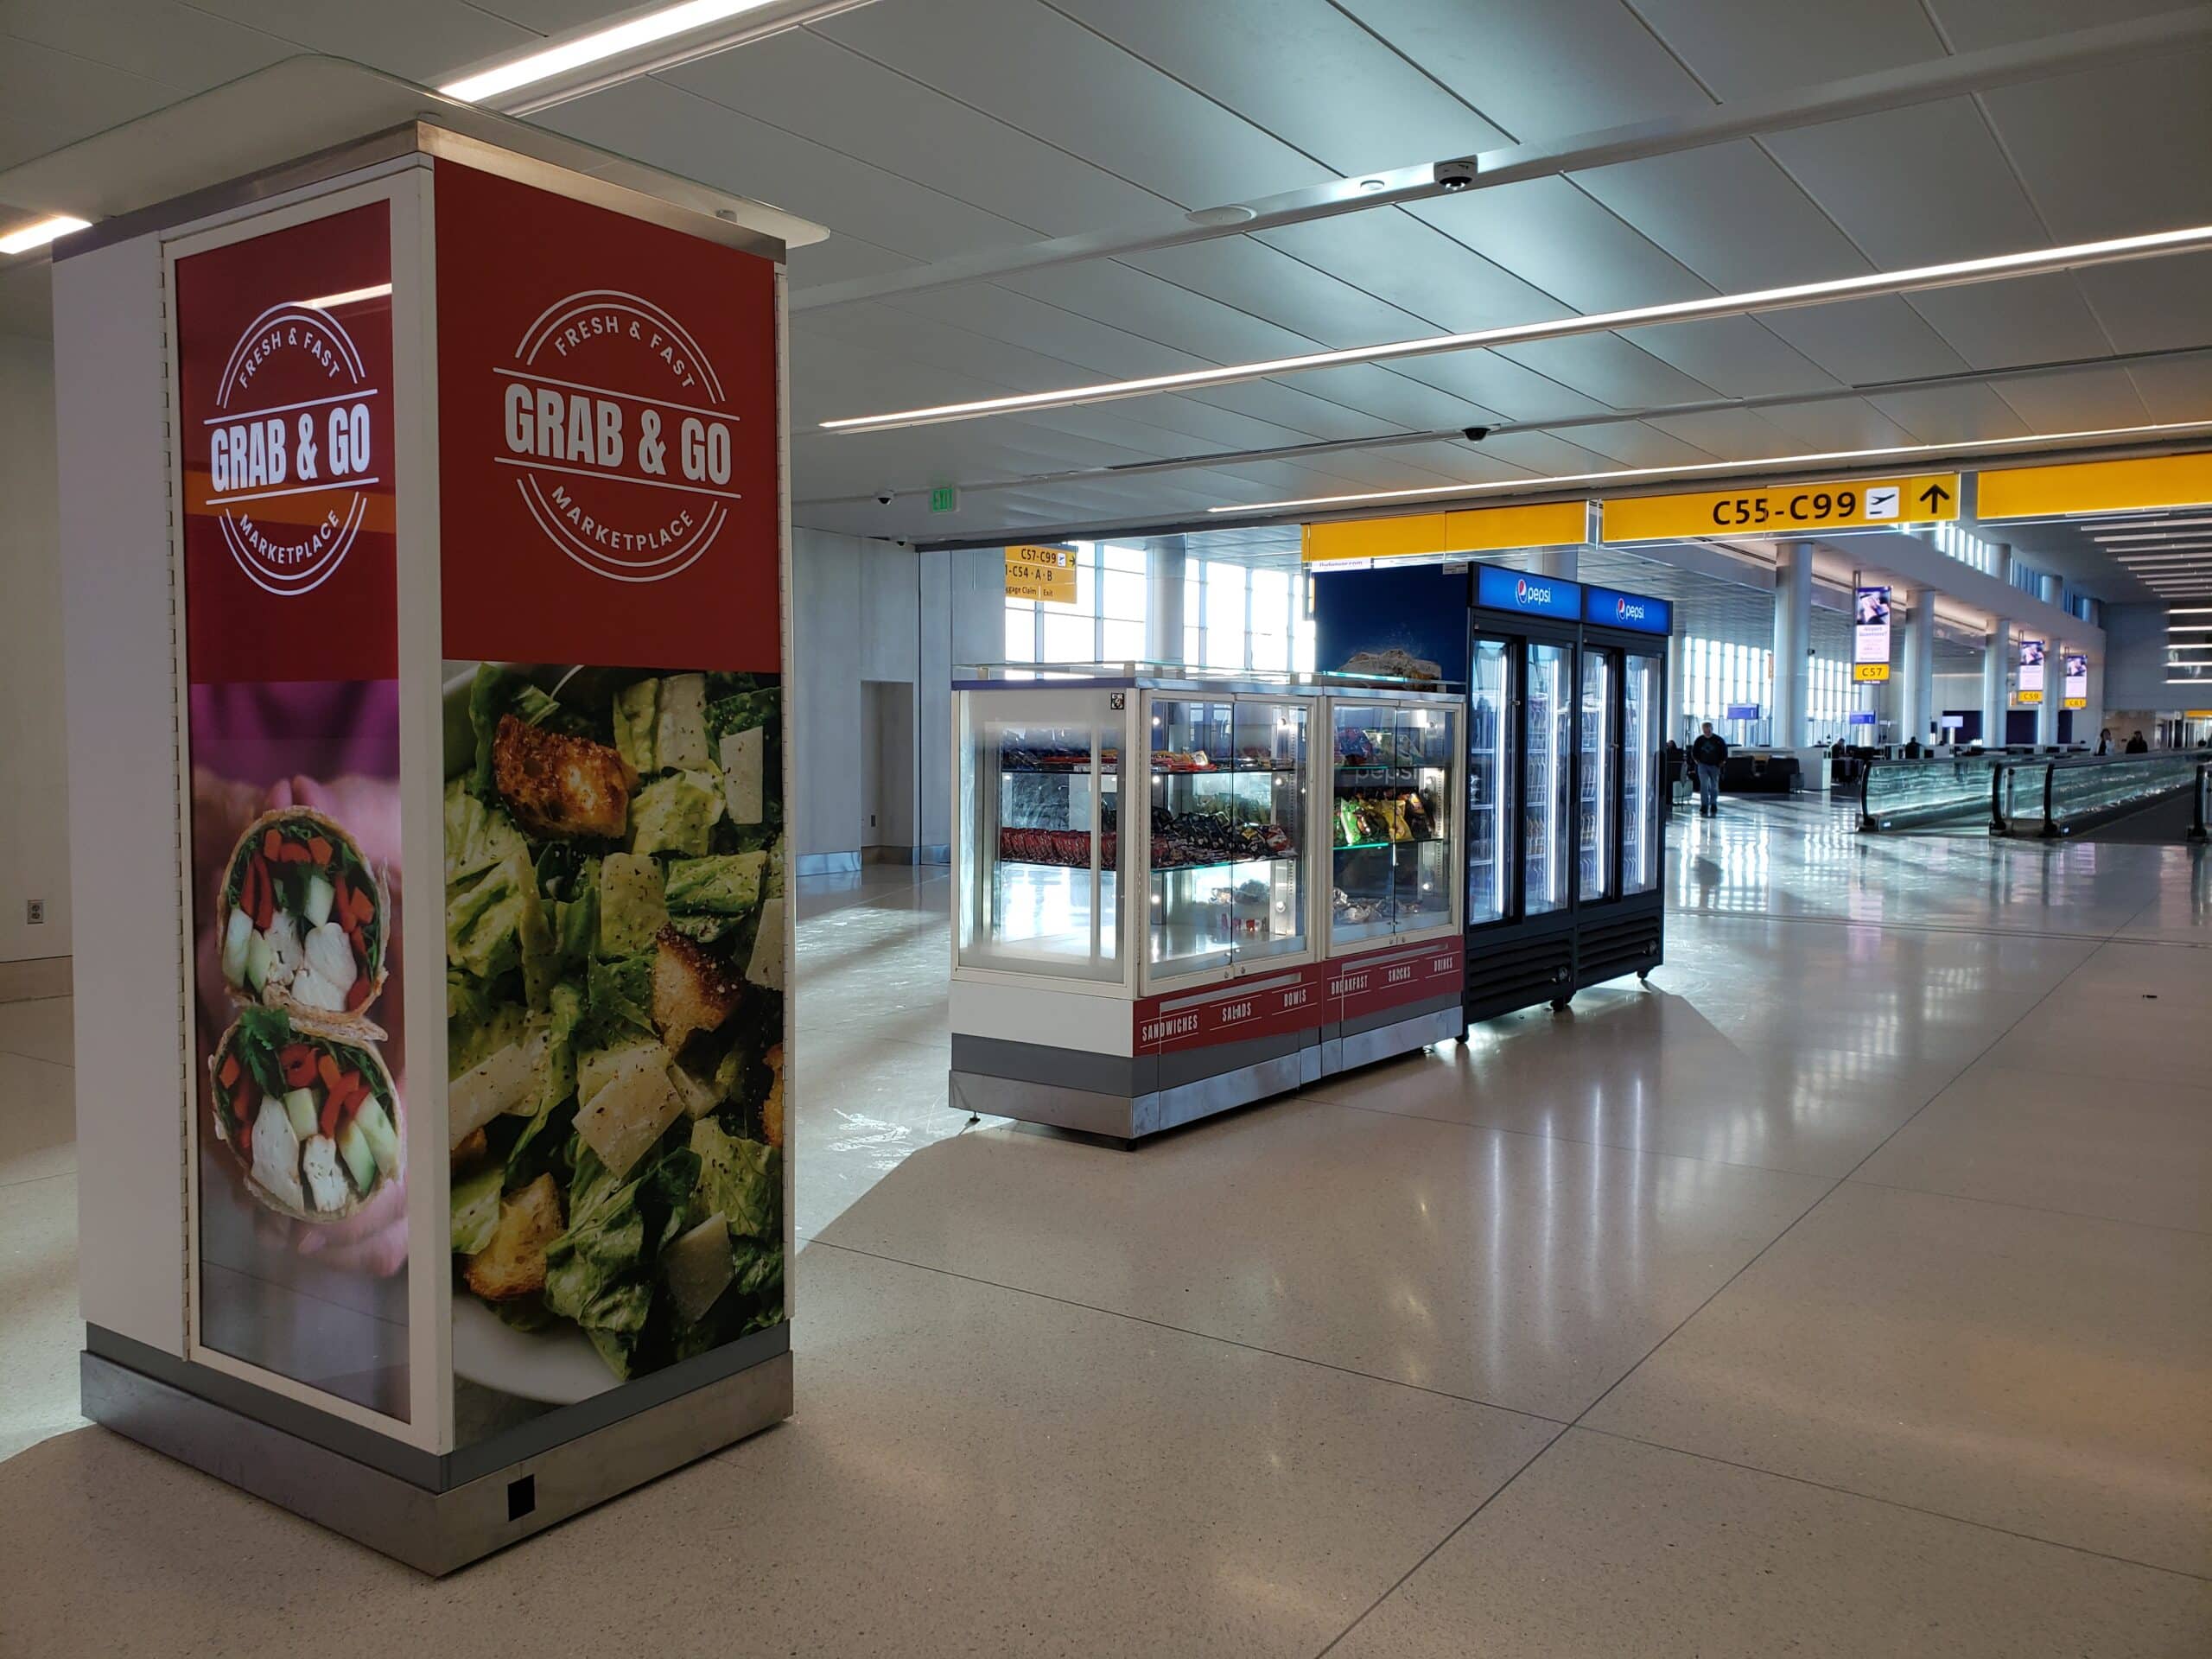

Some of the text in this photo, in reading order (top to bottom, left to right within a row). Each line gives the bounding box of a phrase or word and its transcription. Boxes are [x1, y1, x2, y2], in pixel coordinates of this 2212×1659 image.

[238, 327, 340, 389] FRESH & FAST
[555, 315, 695, 388] FRESH & FAST
[210, 403, 371, 493] GRAB & GO
[505, 383, 731, 486] GRAB & GO
[551, 486, 694, 551] MARKETPLACE
[1713, 492, 1856, 525] C55-C99
[239, 509, 340, 564] MARKETPLACE
[1021, 549, 1057, 564] C57-C99
[1528, 587, 1551, 606] pepsi
[1625, 605, 1644, 621] pepsi
[1861, 667, 1883, 677] C57
[1331, 975, 1369, 995] BREAKFAST
[1222, 1001, 1252, 1022] SALADS
[1141, 1014, 1198, 1042] SANDWICHES
